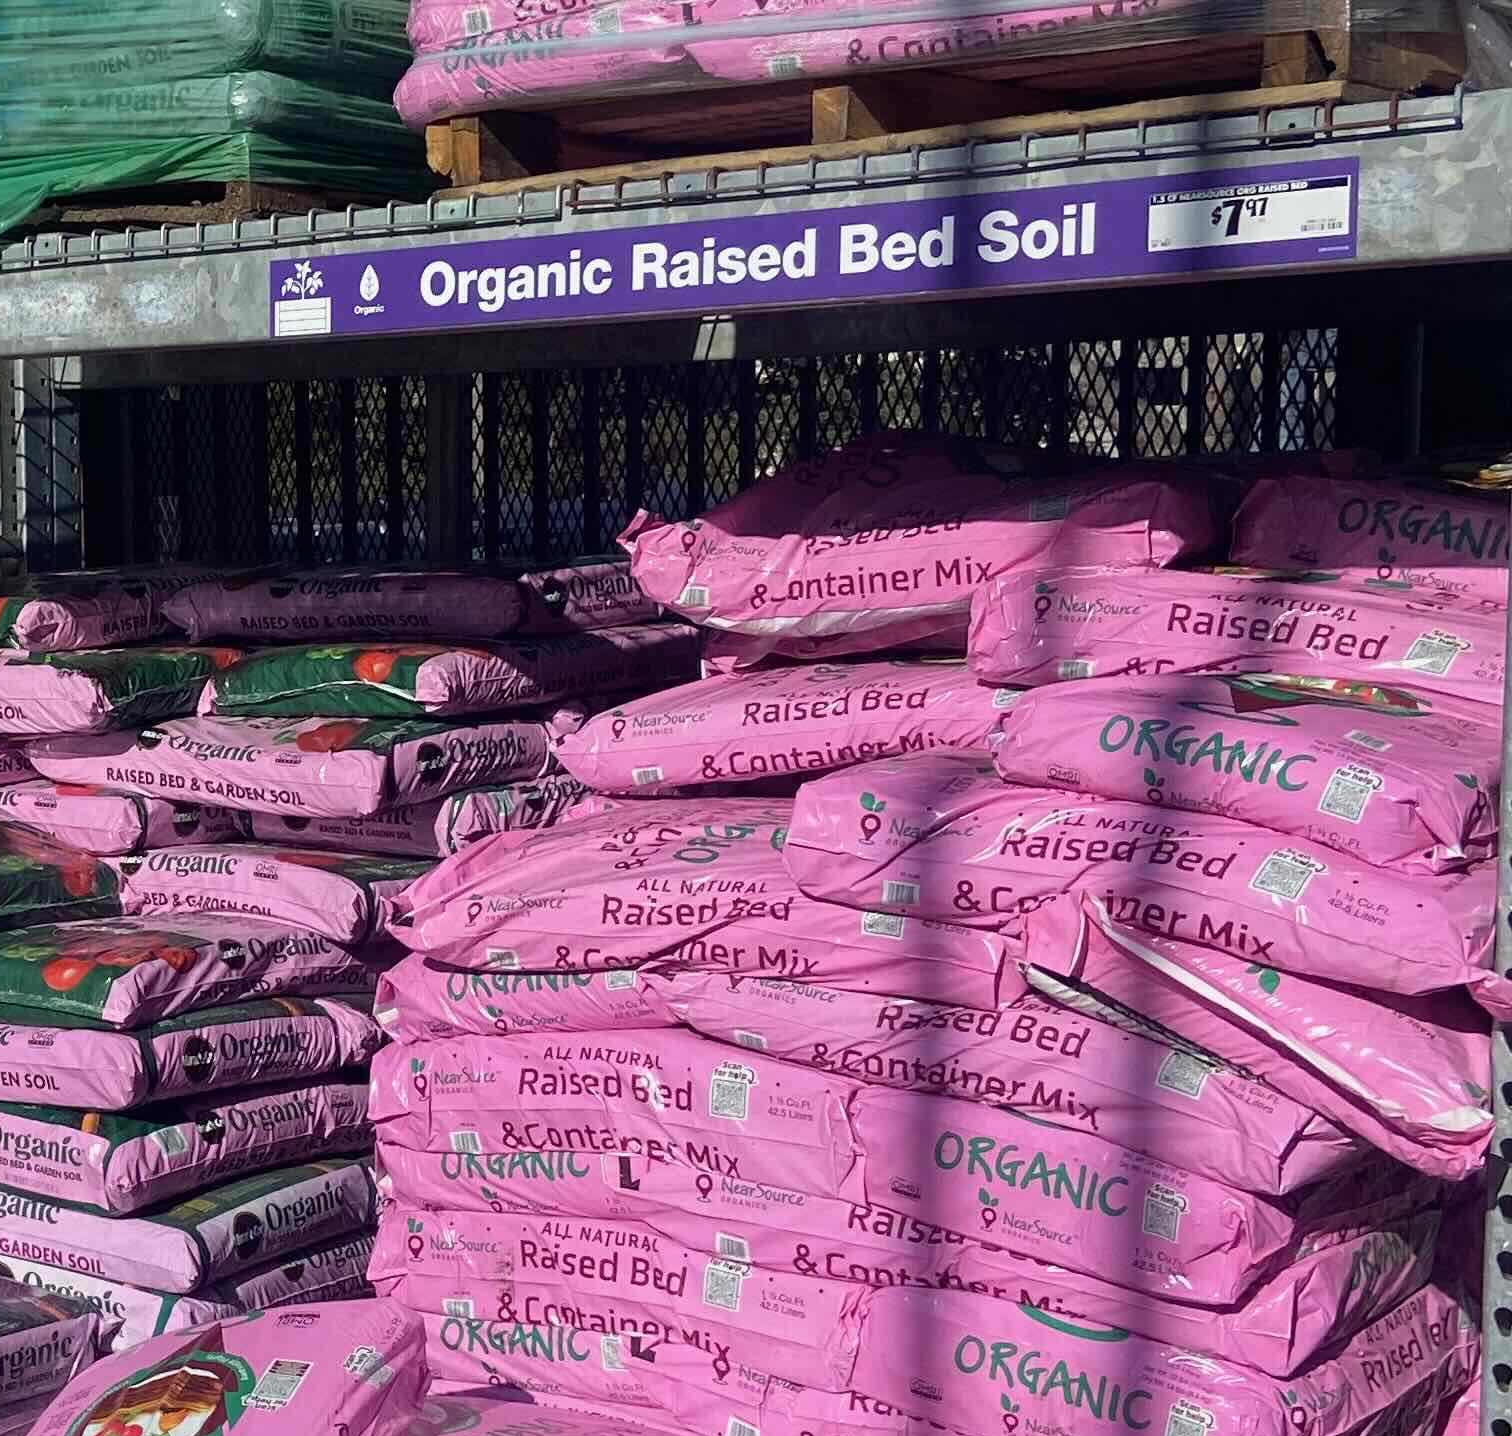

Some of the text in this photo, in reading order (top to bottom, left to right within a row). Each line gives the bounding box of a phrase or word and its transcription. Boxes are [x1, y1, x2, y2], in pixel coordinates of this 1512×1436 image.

[1259, 183, 1288, 194] RAISED
[420, 202, 1096, 313] Organic Raised Bed Soil
[354, 305, 384, 315] Organic
[935, 557, 992, 587] Mix
[337, 614, 395, 628] GARDEN
[399, 615, 432, 628] SOIL
[1168, 603, 1389, 660] Raised Bed
[742, 687, 930, 727] Raised Bed
[168, 736, 262, 763] Organic
[1098, 715, 1317, 791] ORGANIC
[105, 767, 306, 806] RAISED BED GARDEN SOIL
[148, 853, 238, 878] Organic
[1000, 829, 1237, 879] Raised Bed
[637, 878, 768, 894] ALL NATURAL
[602, 895, 791, 926] Raised Bed
[1199, 914, 1274, 960] Mix
[24, 1073, 60, 1091] SOIL
[519, 1067, 692, 1112] Raised Bed
[10, 1156, 24, 1168] BED
[63, 1168, 82, 1180] SOIL
[934, 1131, 1128, 1216] ORGANIC
[1002, 1211, 1074, 1244] NearSource
[0, 1236, 63, 1264] GARDEN
[67, 1252, 106, 1275] SOIL
[440, 1318, 589, 1361] ORGANIC
[954, 1335, 1153, 1430] ORGANIC
